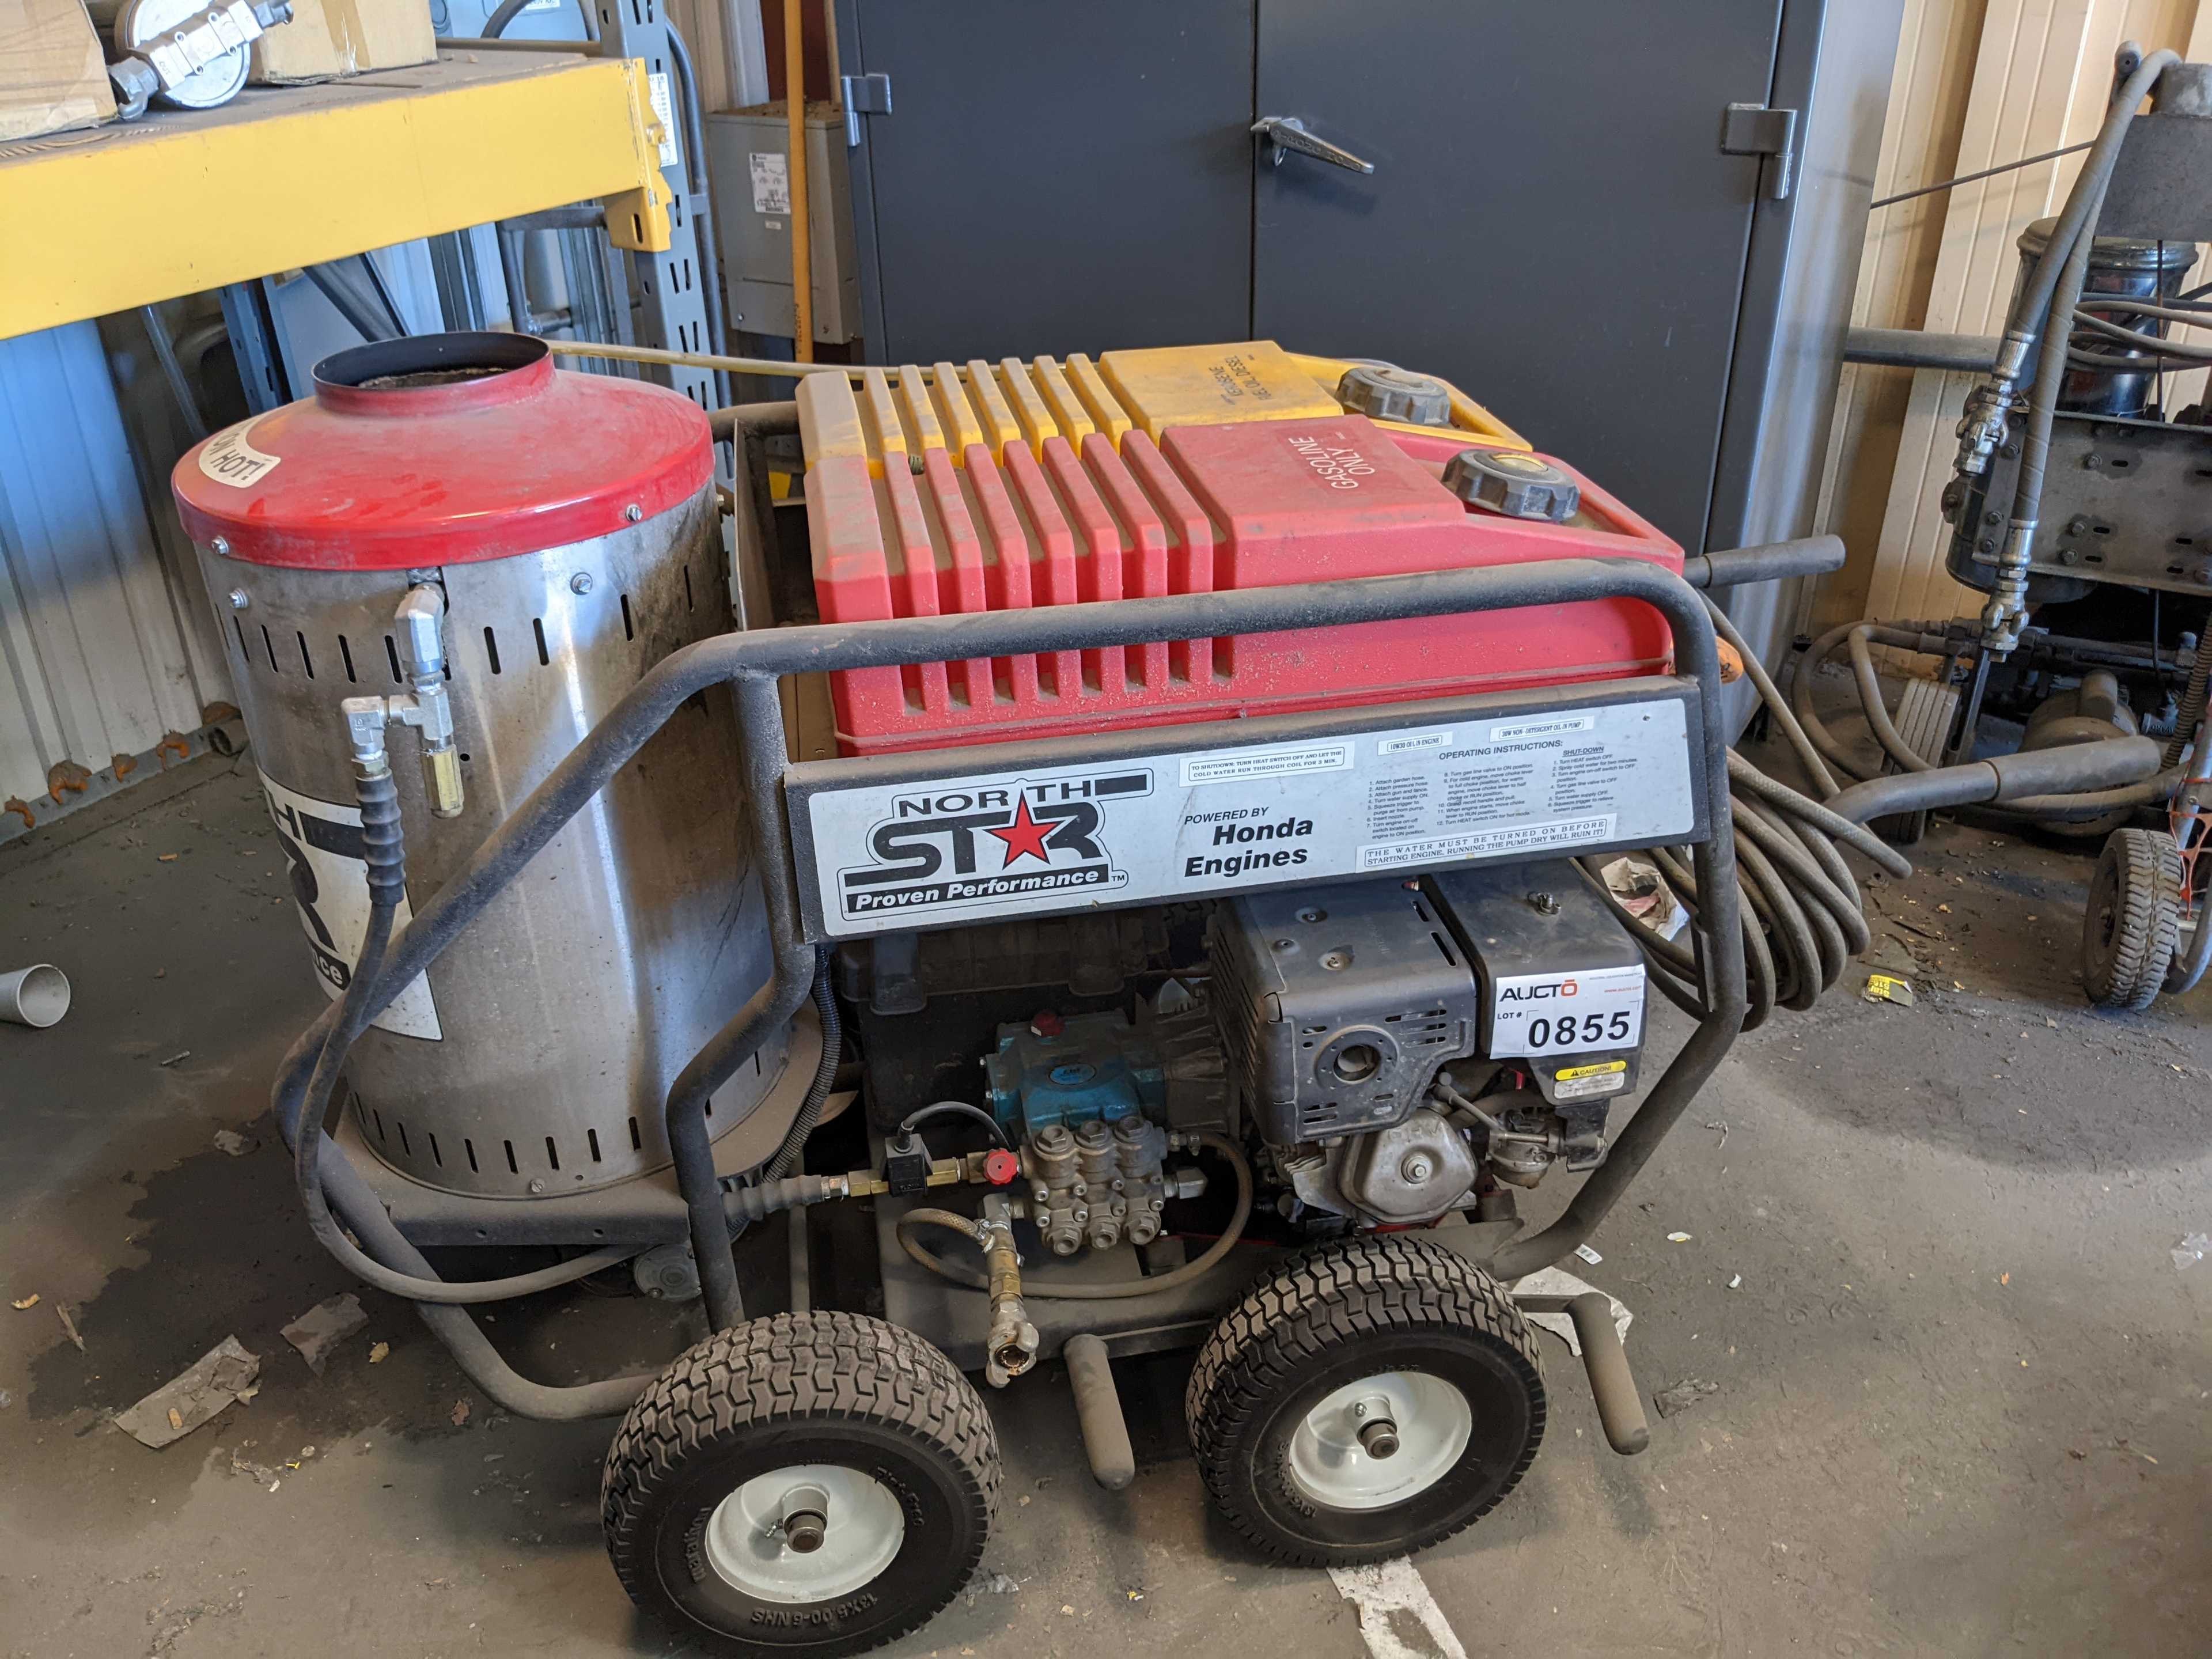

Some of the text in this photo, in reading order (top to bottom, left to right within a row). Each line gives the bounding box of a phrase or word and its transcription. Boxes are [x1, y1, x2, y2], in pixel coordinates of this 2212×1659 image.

[210, 449, 265, 480] HOT!
[1288, 437, 1359, 488] GASOLINE
[1327, 448, 1375, 475] ONLY
[1439, 740, 1563, 760] OPERATING INSTRUCTIONS:
[1563, 747, 1604, 757] SHUT-DOWN
[1184, 807, 1269, 824] POWERED BY
[1213, 817, 1313, 846] Honda
[1396, 843, 1433, 854] WATER
[1438, 839, 1468, 848] MUST
[1493, 831, 1536, 841] TURNED
[1562, 821, 1604, 832] BEFORE
[1184, 849, 1308, 877] Engines
[1368, 854, 1408, 865] STARTING
[1447, 844, 1484, 854] RUNNING
[855, 889, 944, 910] Proven
[947, 871, 1099, 899] Performance
[1528, 1011, 1630, 1048] 0855
[1580, 1066, 1611, 1075] CAUTION!
[751, 1608, 790, 1626] NHS
